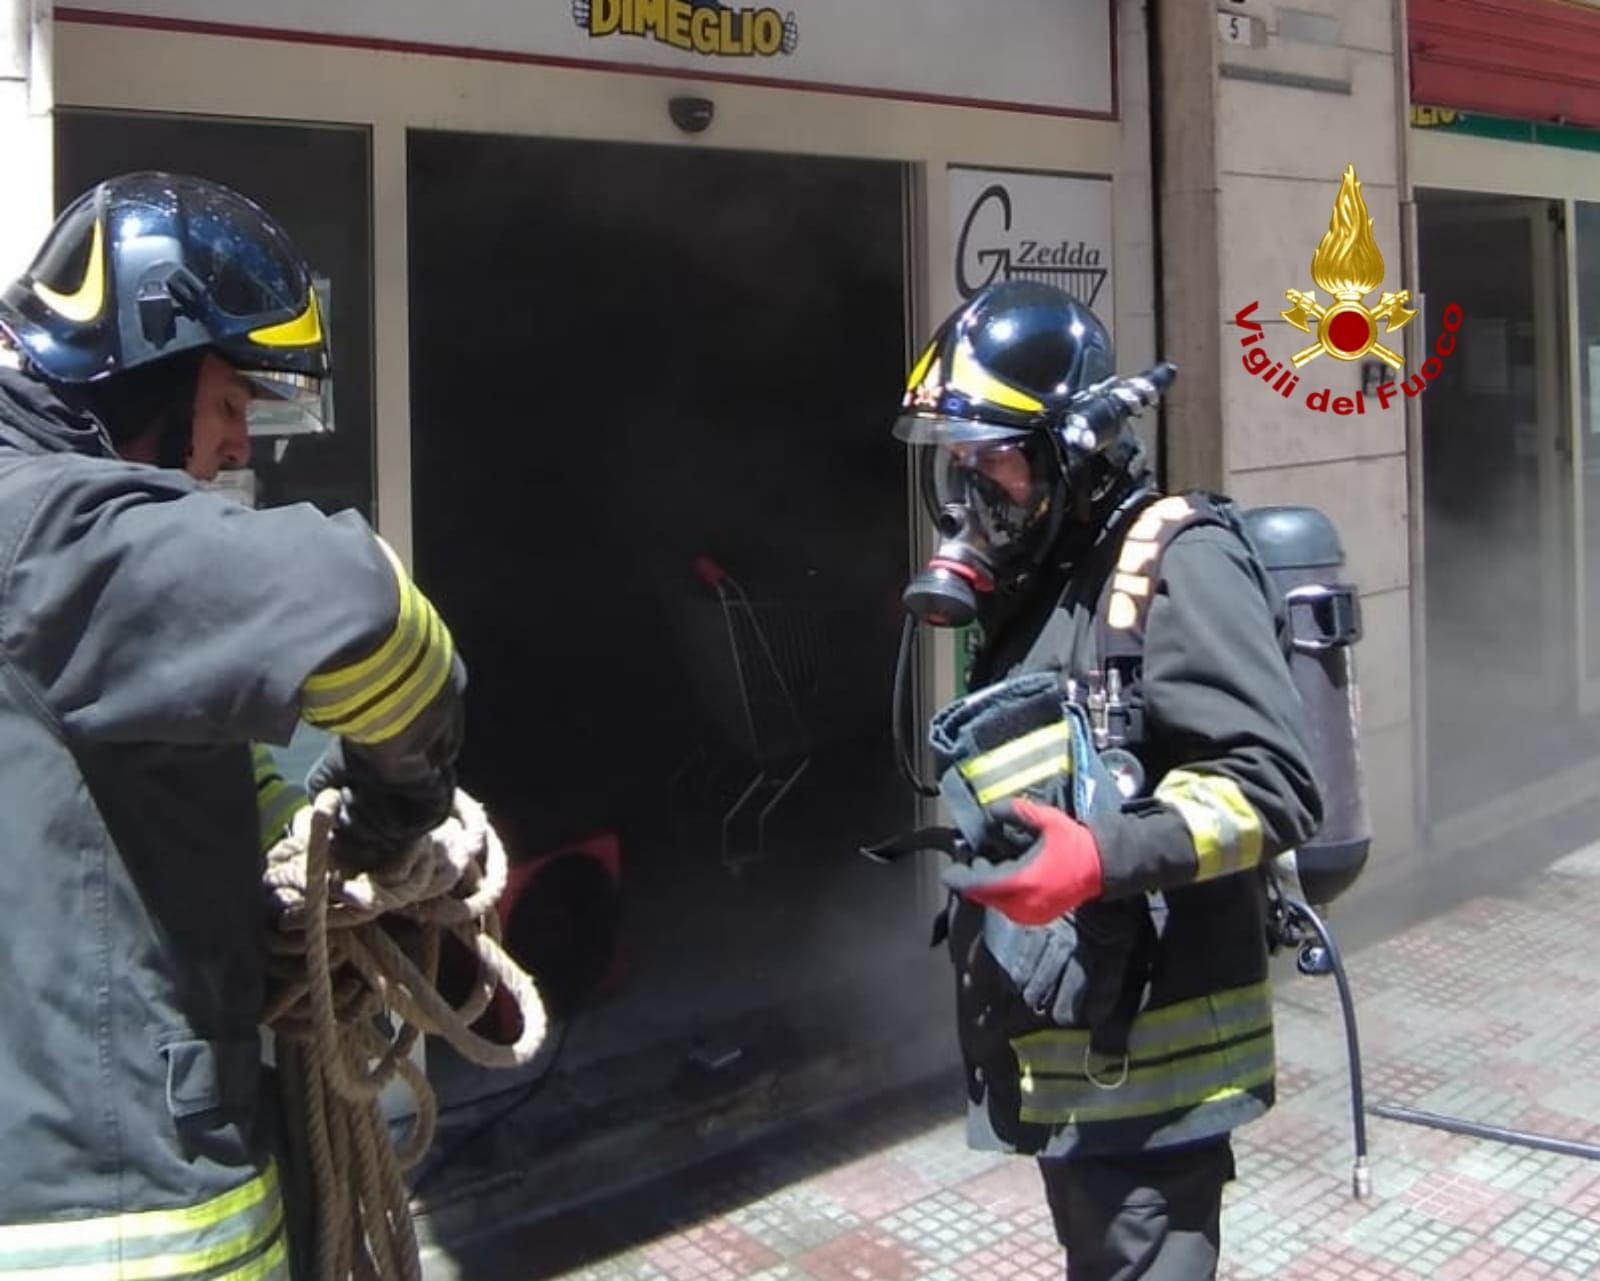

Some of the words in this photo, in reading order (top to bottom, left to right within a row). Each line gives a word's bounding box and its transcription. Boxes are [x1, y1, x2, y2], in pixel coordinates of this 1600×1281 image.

[589, 0, 783, 56] DIMEGLIO
[1229, 17, 1239, 40] 5
[956, 184, 1011, 300] G
[1017, 241, 1100, 266] Zedda
